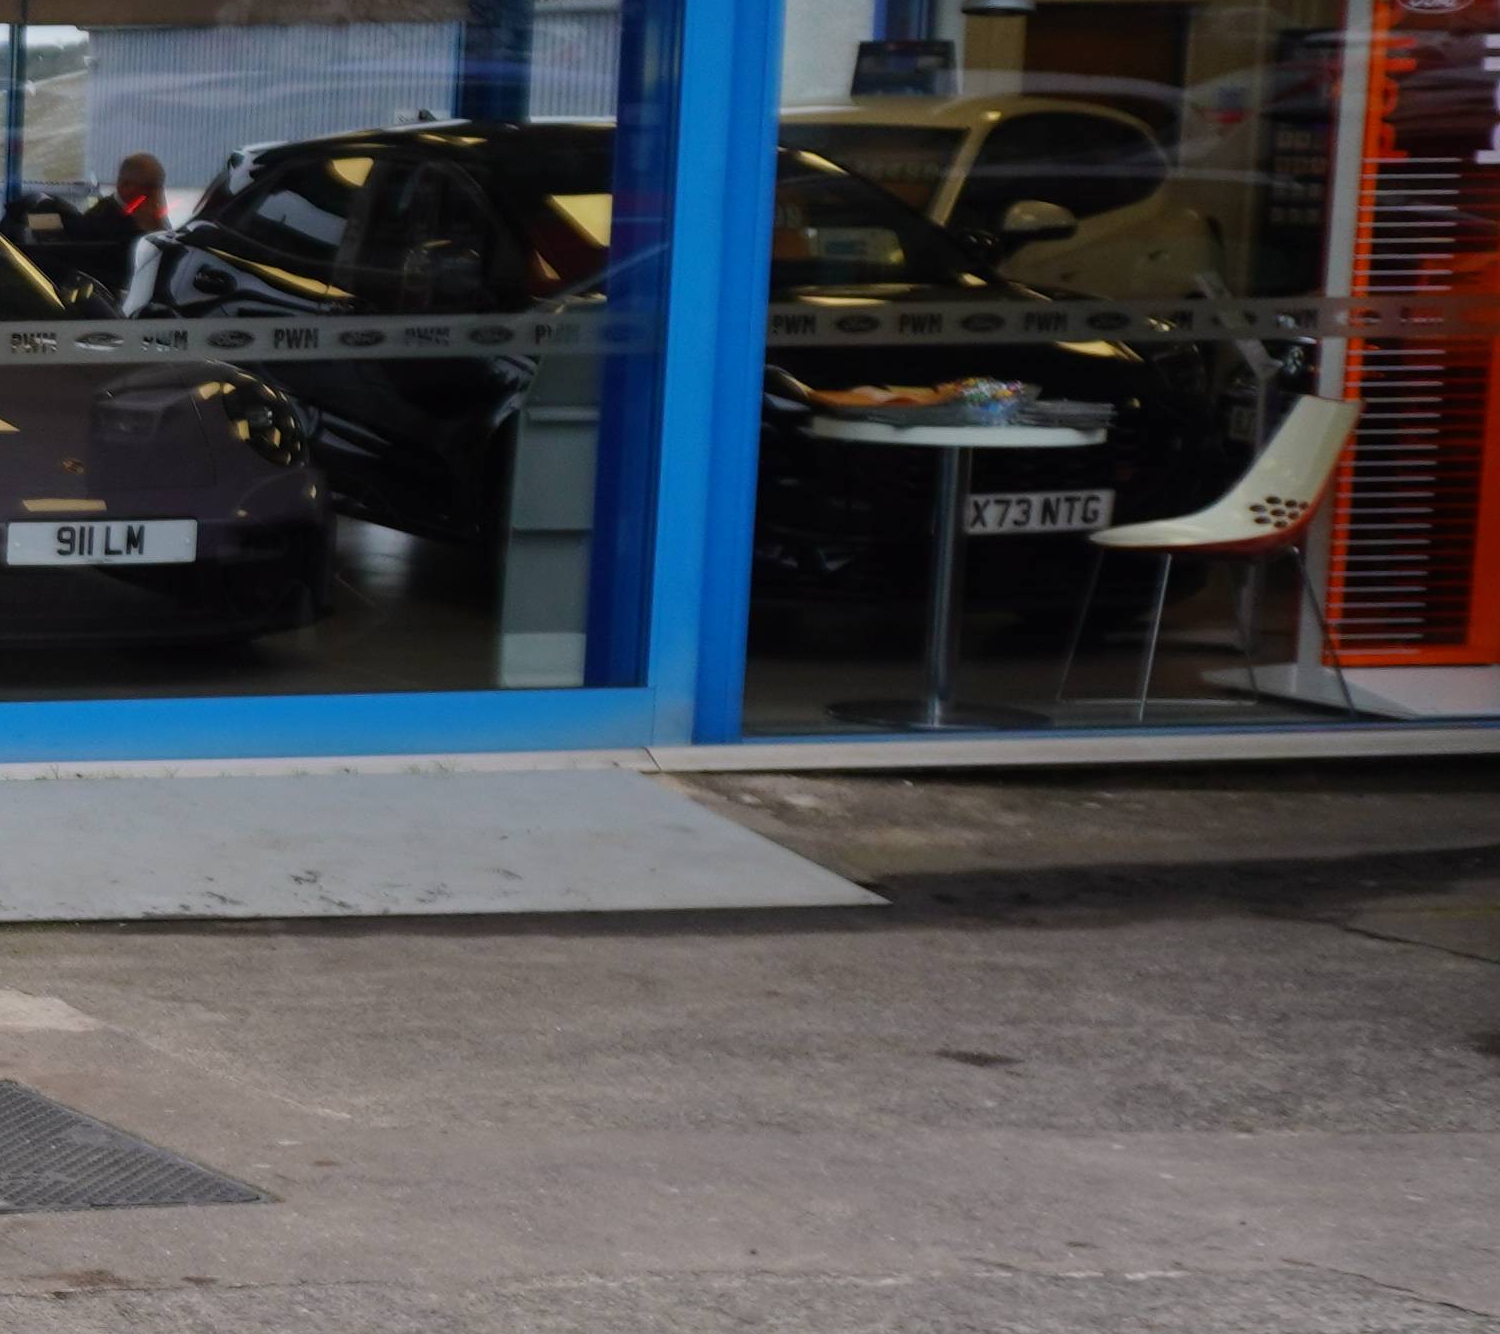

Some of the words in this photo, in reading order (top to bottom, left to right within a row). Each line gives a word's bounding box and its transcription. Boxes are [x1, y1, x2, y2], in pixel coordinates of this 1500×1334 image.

[970, 498, 1032, 528] X73
[1040, 495, 1101, 525] NTG
[57, 526, 94, 556] 911
[105, 525, 145, 555] LM
